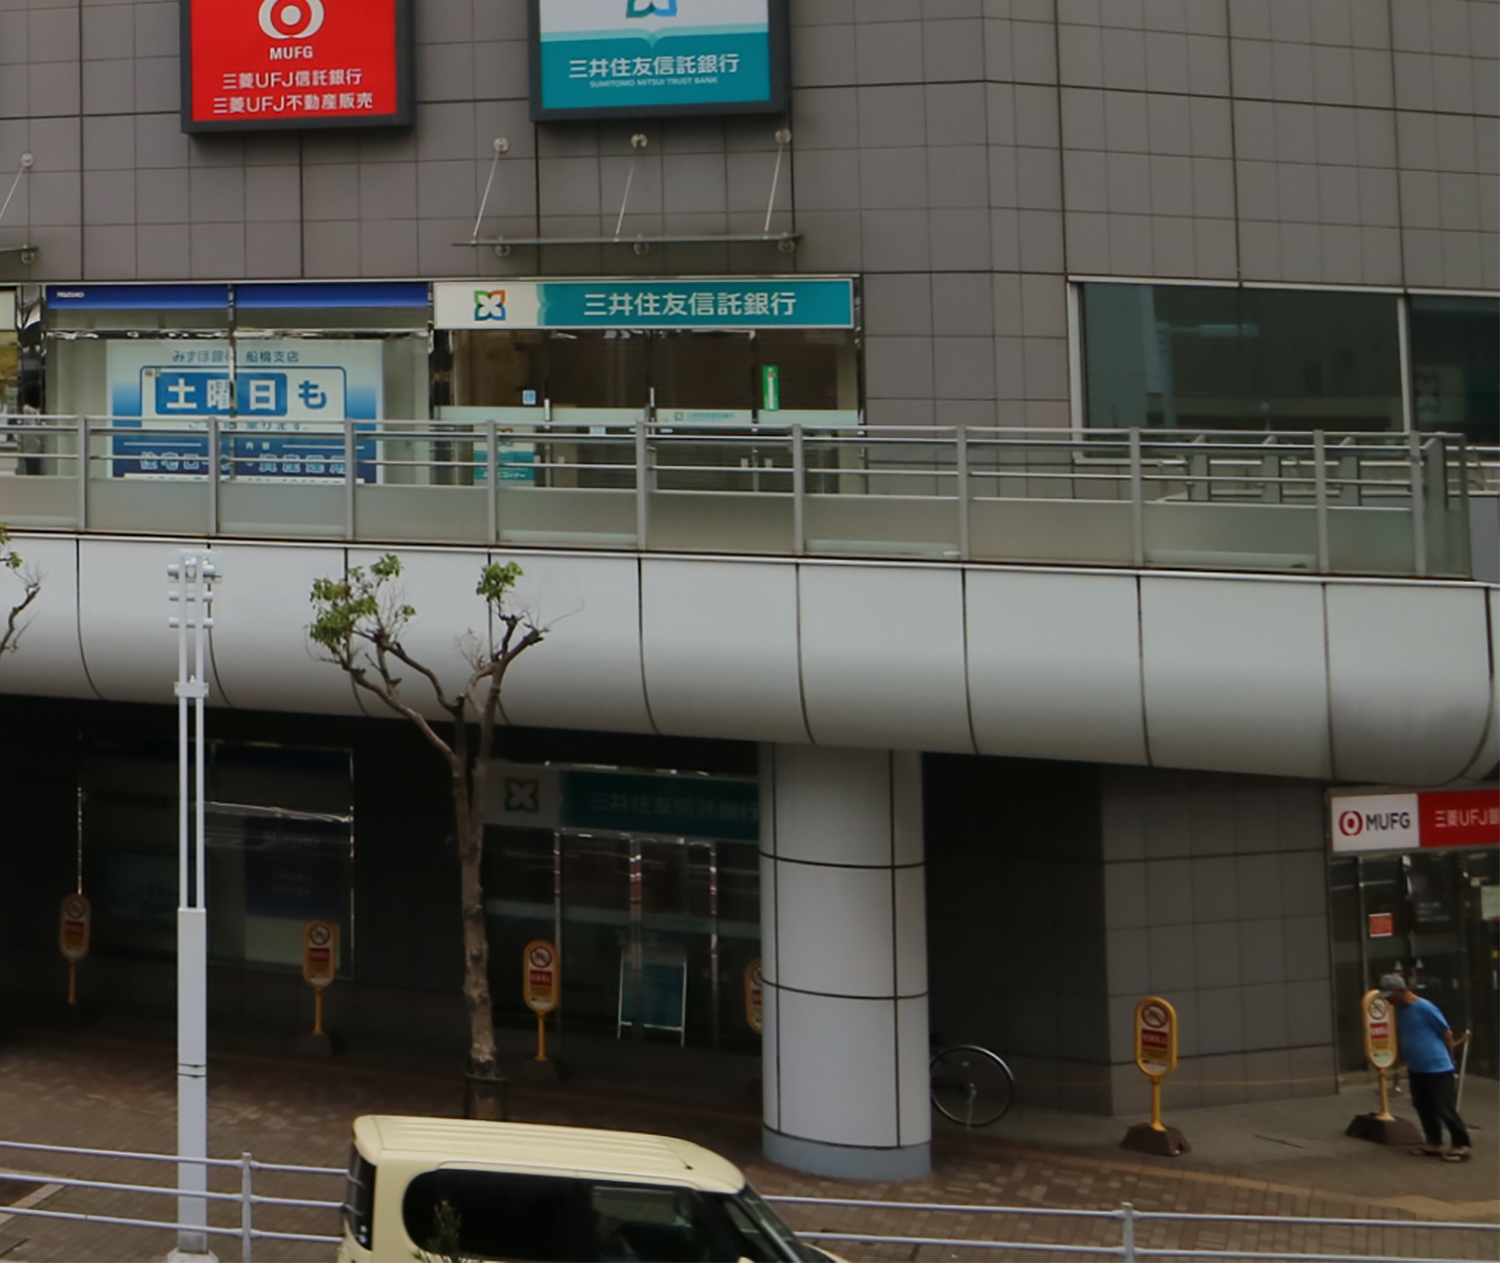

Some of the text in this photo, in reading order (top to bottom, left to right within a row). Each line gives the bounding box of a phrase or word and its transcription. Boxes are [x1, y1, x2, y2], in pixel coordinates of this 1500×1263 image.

[269, 45, 314, 60] MUFG
[569, 53, 740, 79] 三井住友信託銀行
[222, 68, 362, 89] 三菱UFJ信託銀行
[213, 92, 374, 114] 三菱UFJ不動産販売
[583, 292, 797, 317] 三井住友信託銀行
[246, 349, 300, 363] 船橋支店
[165, 378, 328, 411] 土曜日も
[1366, 812, 1411, 832] MUFG
